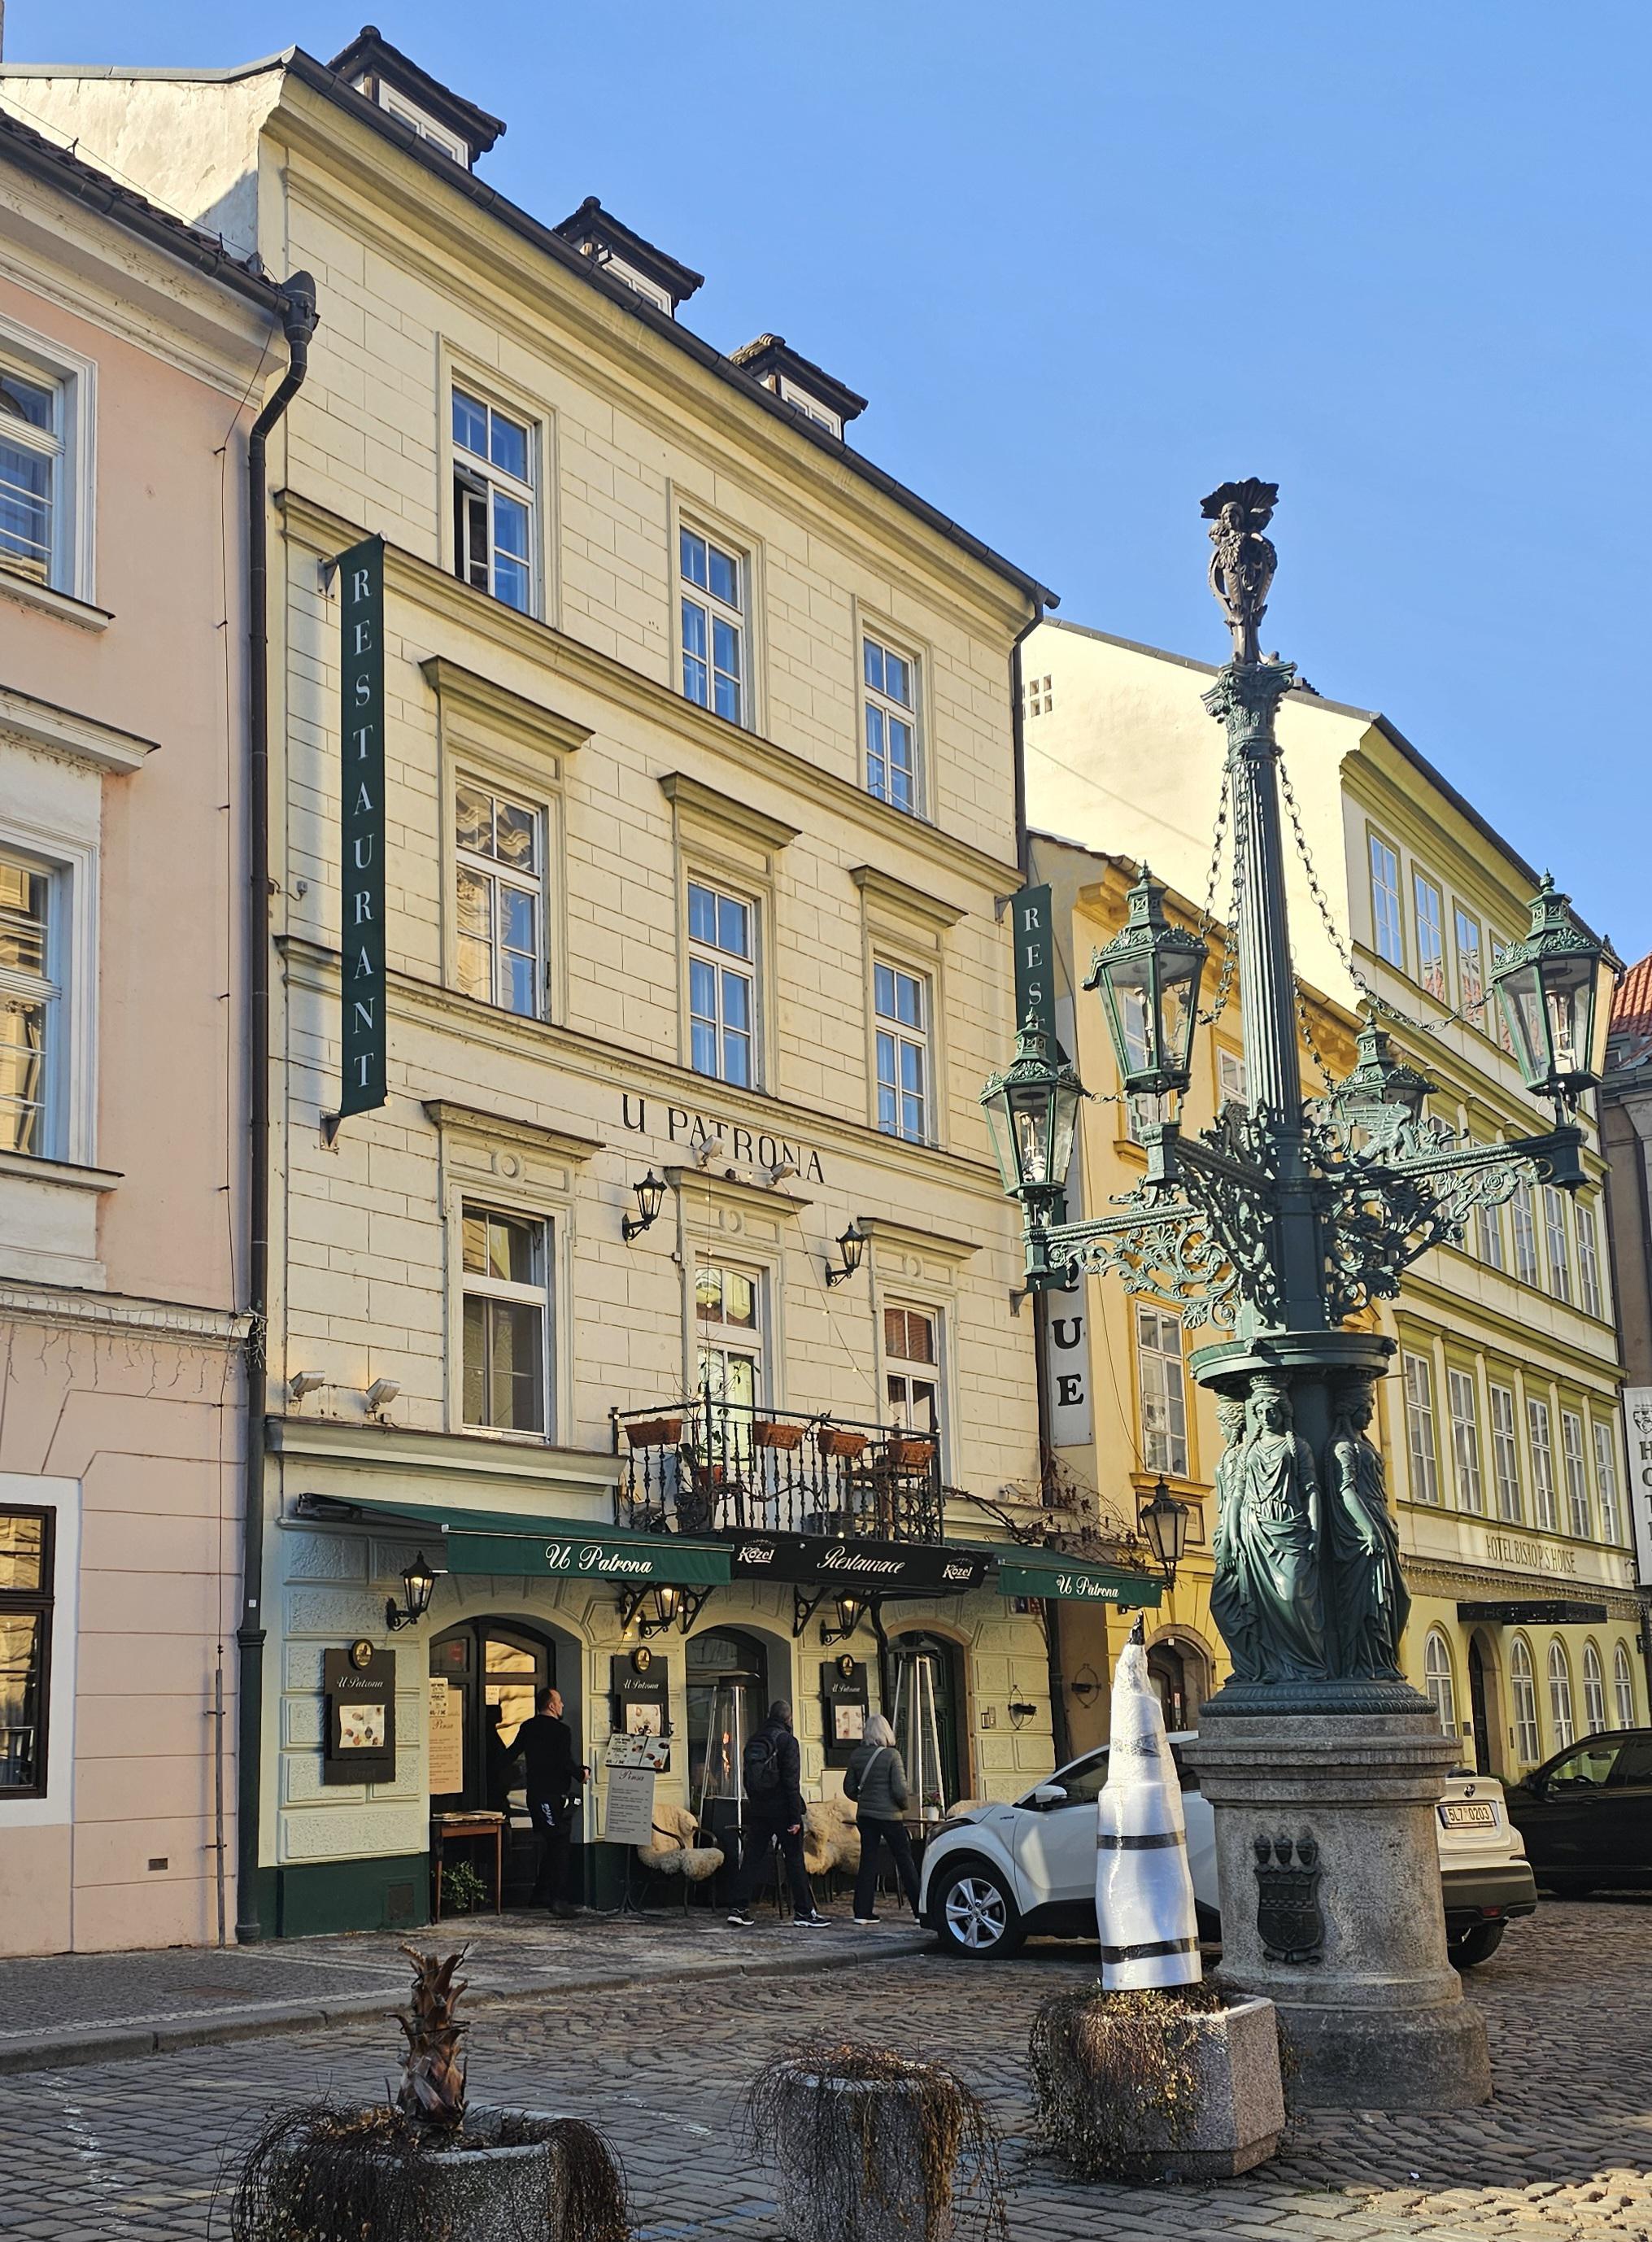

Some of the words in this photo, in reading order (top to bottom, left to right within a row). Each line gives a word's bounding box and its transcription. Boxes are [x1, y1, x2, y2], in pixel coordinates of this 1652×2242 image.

[351, 567, 375, 1089] RESTAURANT
[622, 1093, 646, 1133] U
[667, 1106, 825, 1184] PATRONA
[545, 1543, 571, 1570] U
[578, 1545, 653, 1574] Patrona
[737, 1546, 775, 1564] Kozel
[816, 1545, 905, 1575] Restaurace
[942, 1564, 974, 1580] Kozel
[1057, 1574, 1073, 1594] U
[1076, 1576, 1120, 1599] Patrona
[337, 1677, 347, 1688] U
[347, 1676, 384, 1688] Patrona
[618, 1769, 645, 1782] Pinsa
[1448, 1807, 1463, 1821] 5L7
[1468, 1806, 1490, 1821] 0203
